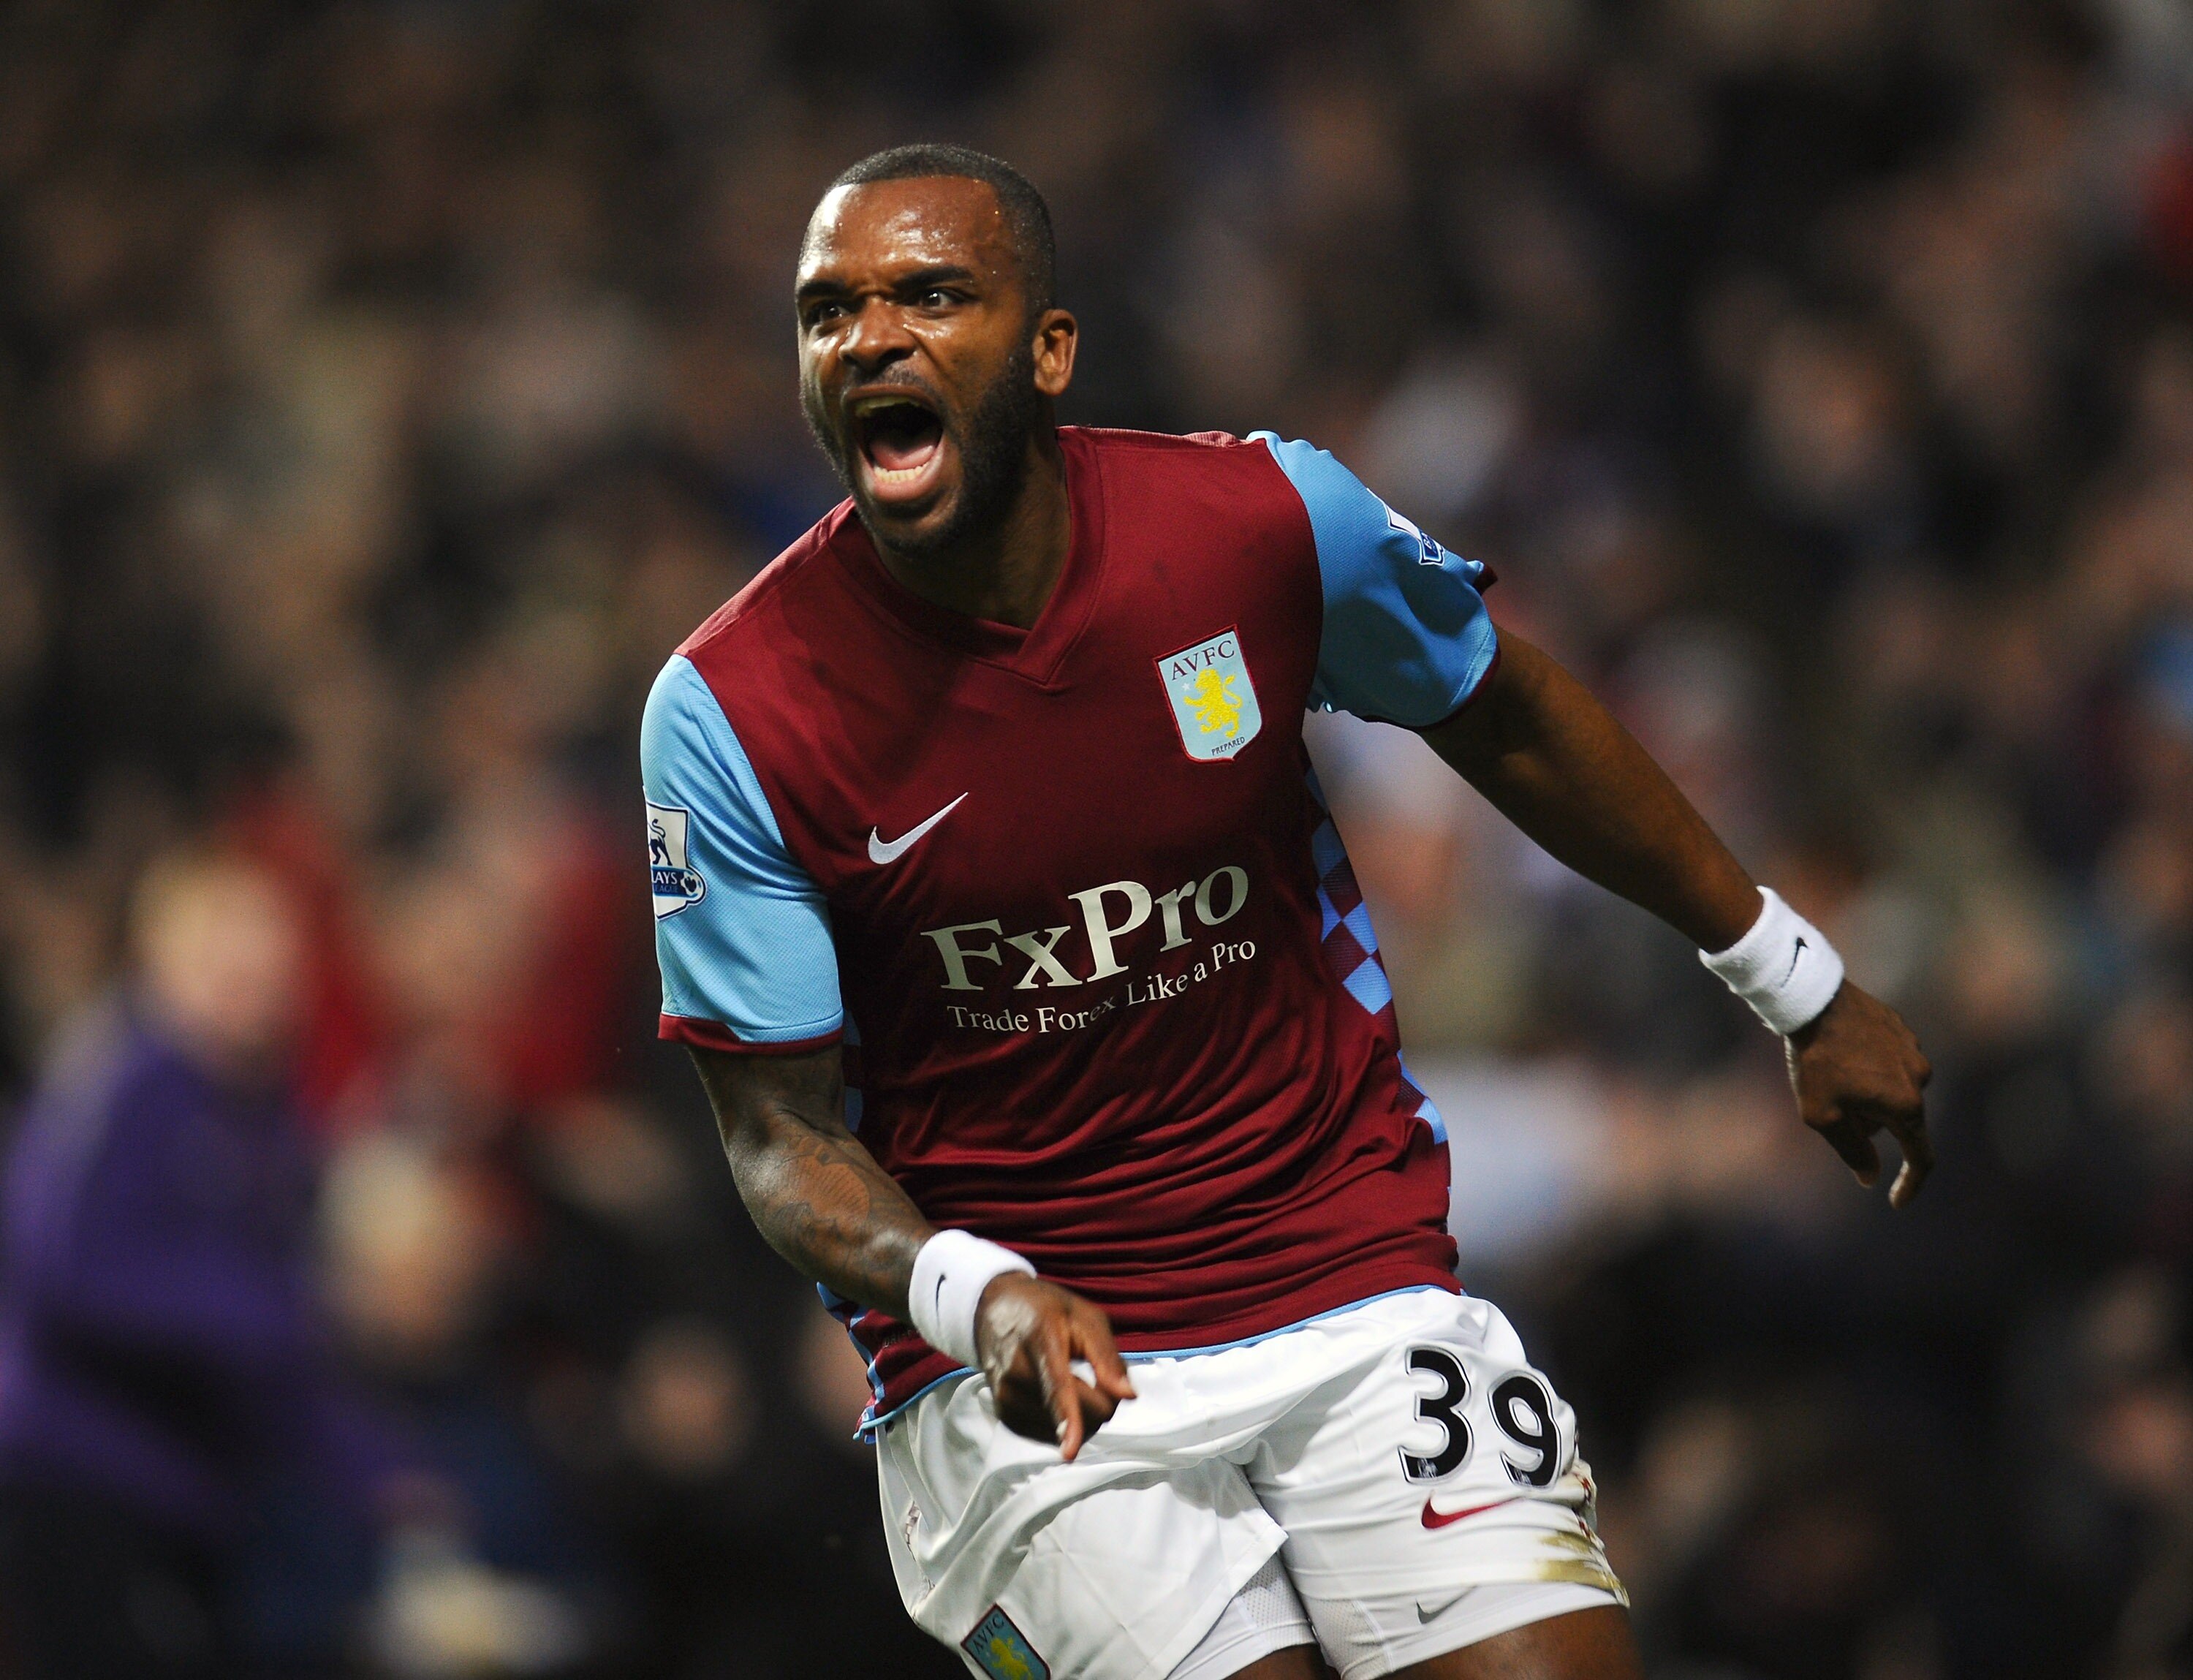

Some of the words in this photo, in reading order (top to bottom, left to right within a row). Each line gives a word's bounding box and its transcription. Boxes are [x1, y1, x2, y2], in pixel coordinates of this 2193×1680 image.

[1172, 640, 1235, 681] AVFC
[1211, 736, 1246, 756] PREPARED
[920, 866, 1249, 991] FxPro
[947, 1005, 1030, 1033] Trade
[1036, 996, 1116, 1033] Forex
[1124, 972, 1189, 1007] Like
[1194, 962, 1208, 983] a
[1211, 940, 1257, 973] Pro
[1397, 1344, 1562, 1490] 39
[972, 1613, 1005, 1654] AVFC
